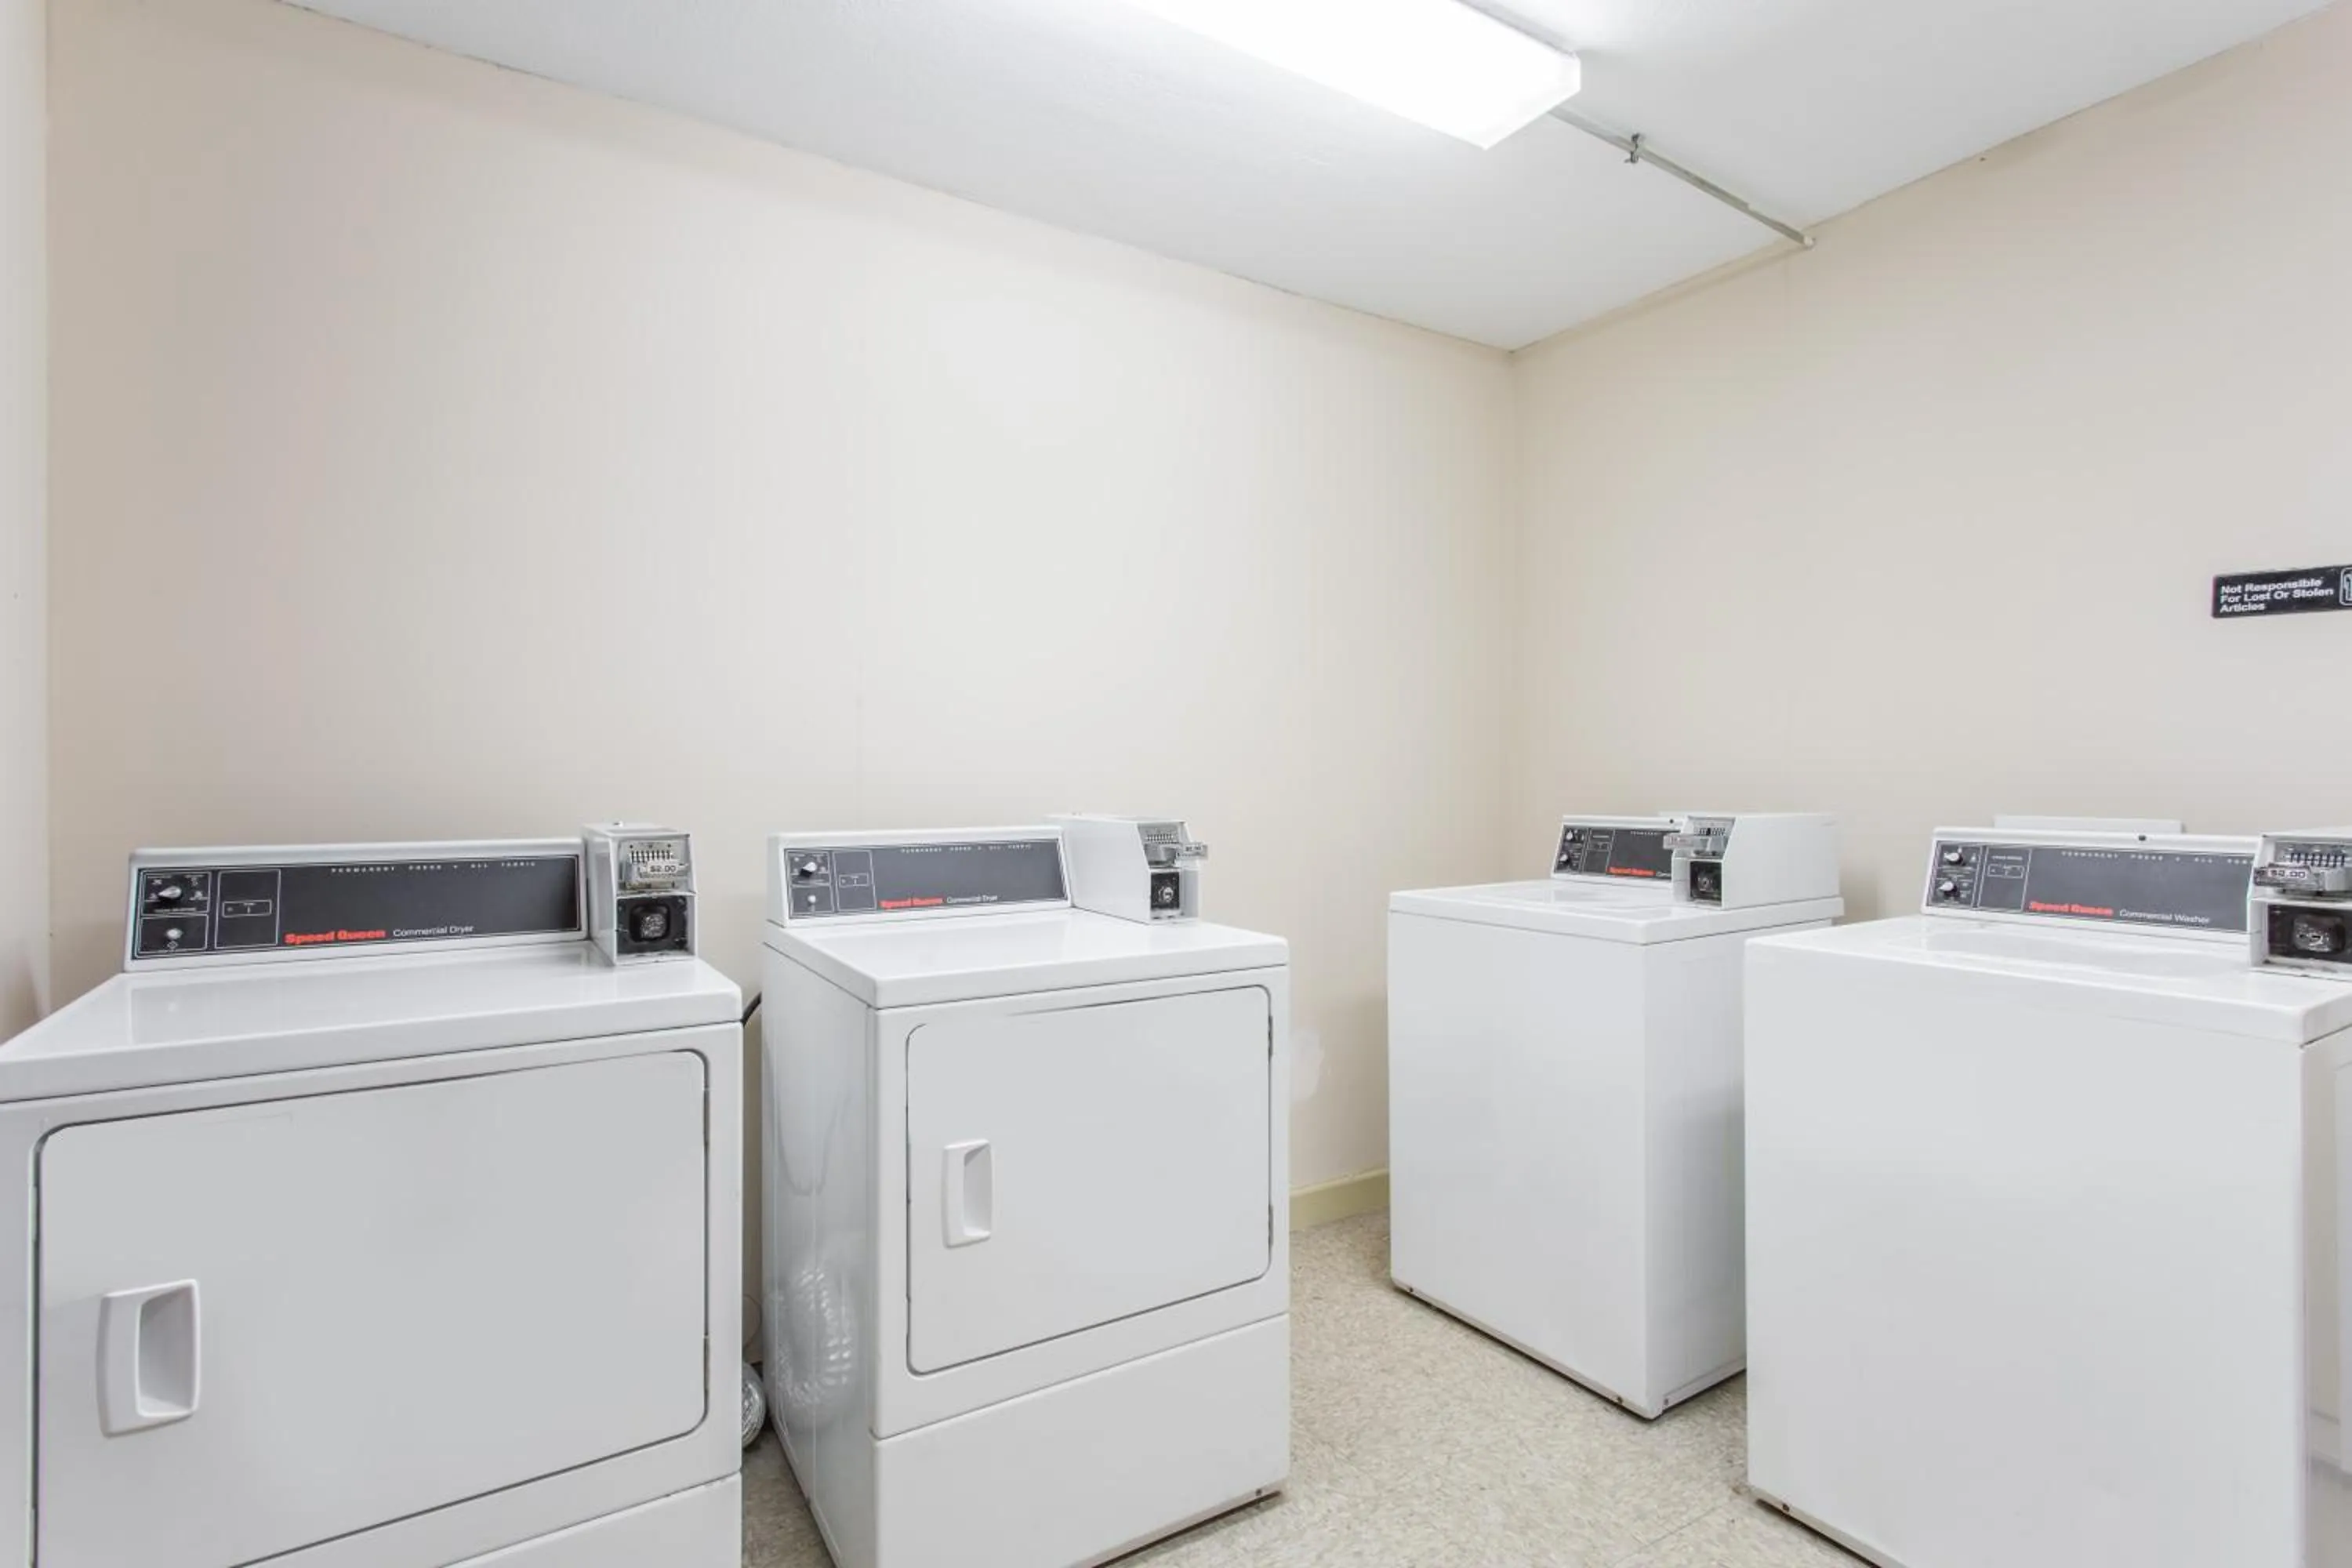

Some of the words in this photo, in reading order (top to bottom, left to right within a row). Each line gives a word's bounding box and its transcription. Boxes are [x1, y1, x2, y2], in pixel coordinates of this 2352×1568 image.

[2220, 585, 2242, 595] Not
[2245, 579, 2322, 593] Responsible
[2220, 594, 2241, 604] For
[2244, 591, 2271, 601] Lost
[2274, 590, 2290, 600] Or
[2292, 588, 2334, 598] Stolen
[2220, 601, 2266, 613] Articles
[2119, 908, 2172, 921] Commercial
[2174, 914, 2210, 924] Washer
[285, 931, 336, 946] Speed
[337, 928, 386, 941] Queen
[393, 926, 448, 938] Commercial
[449, 924, 474, 935] Dryer
